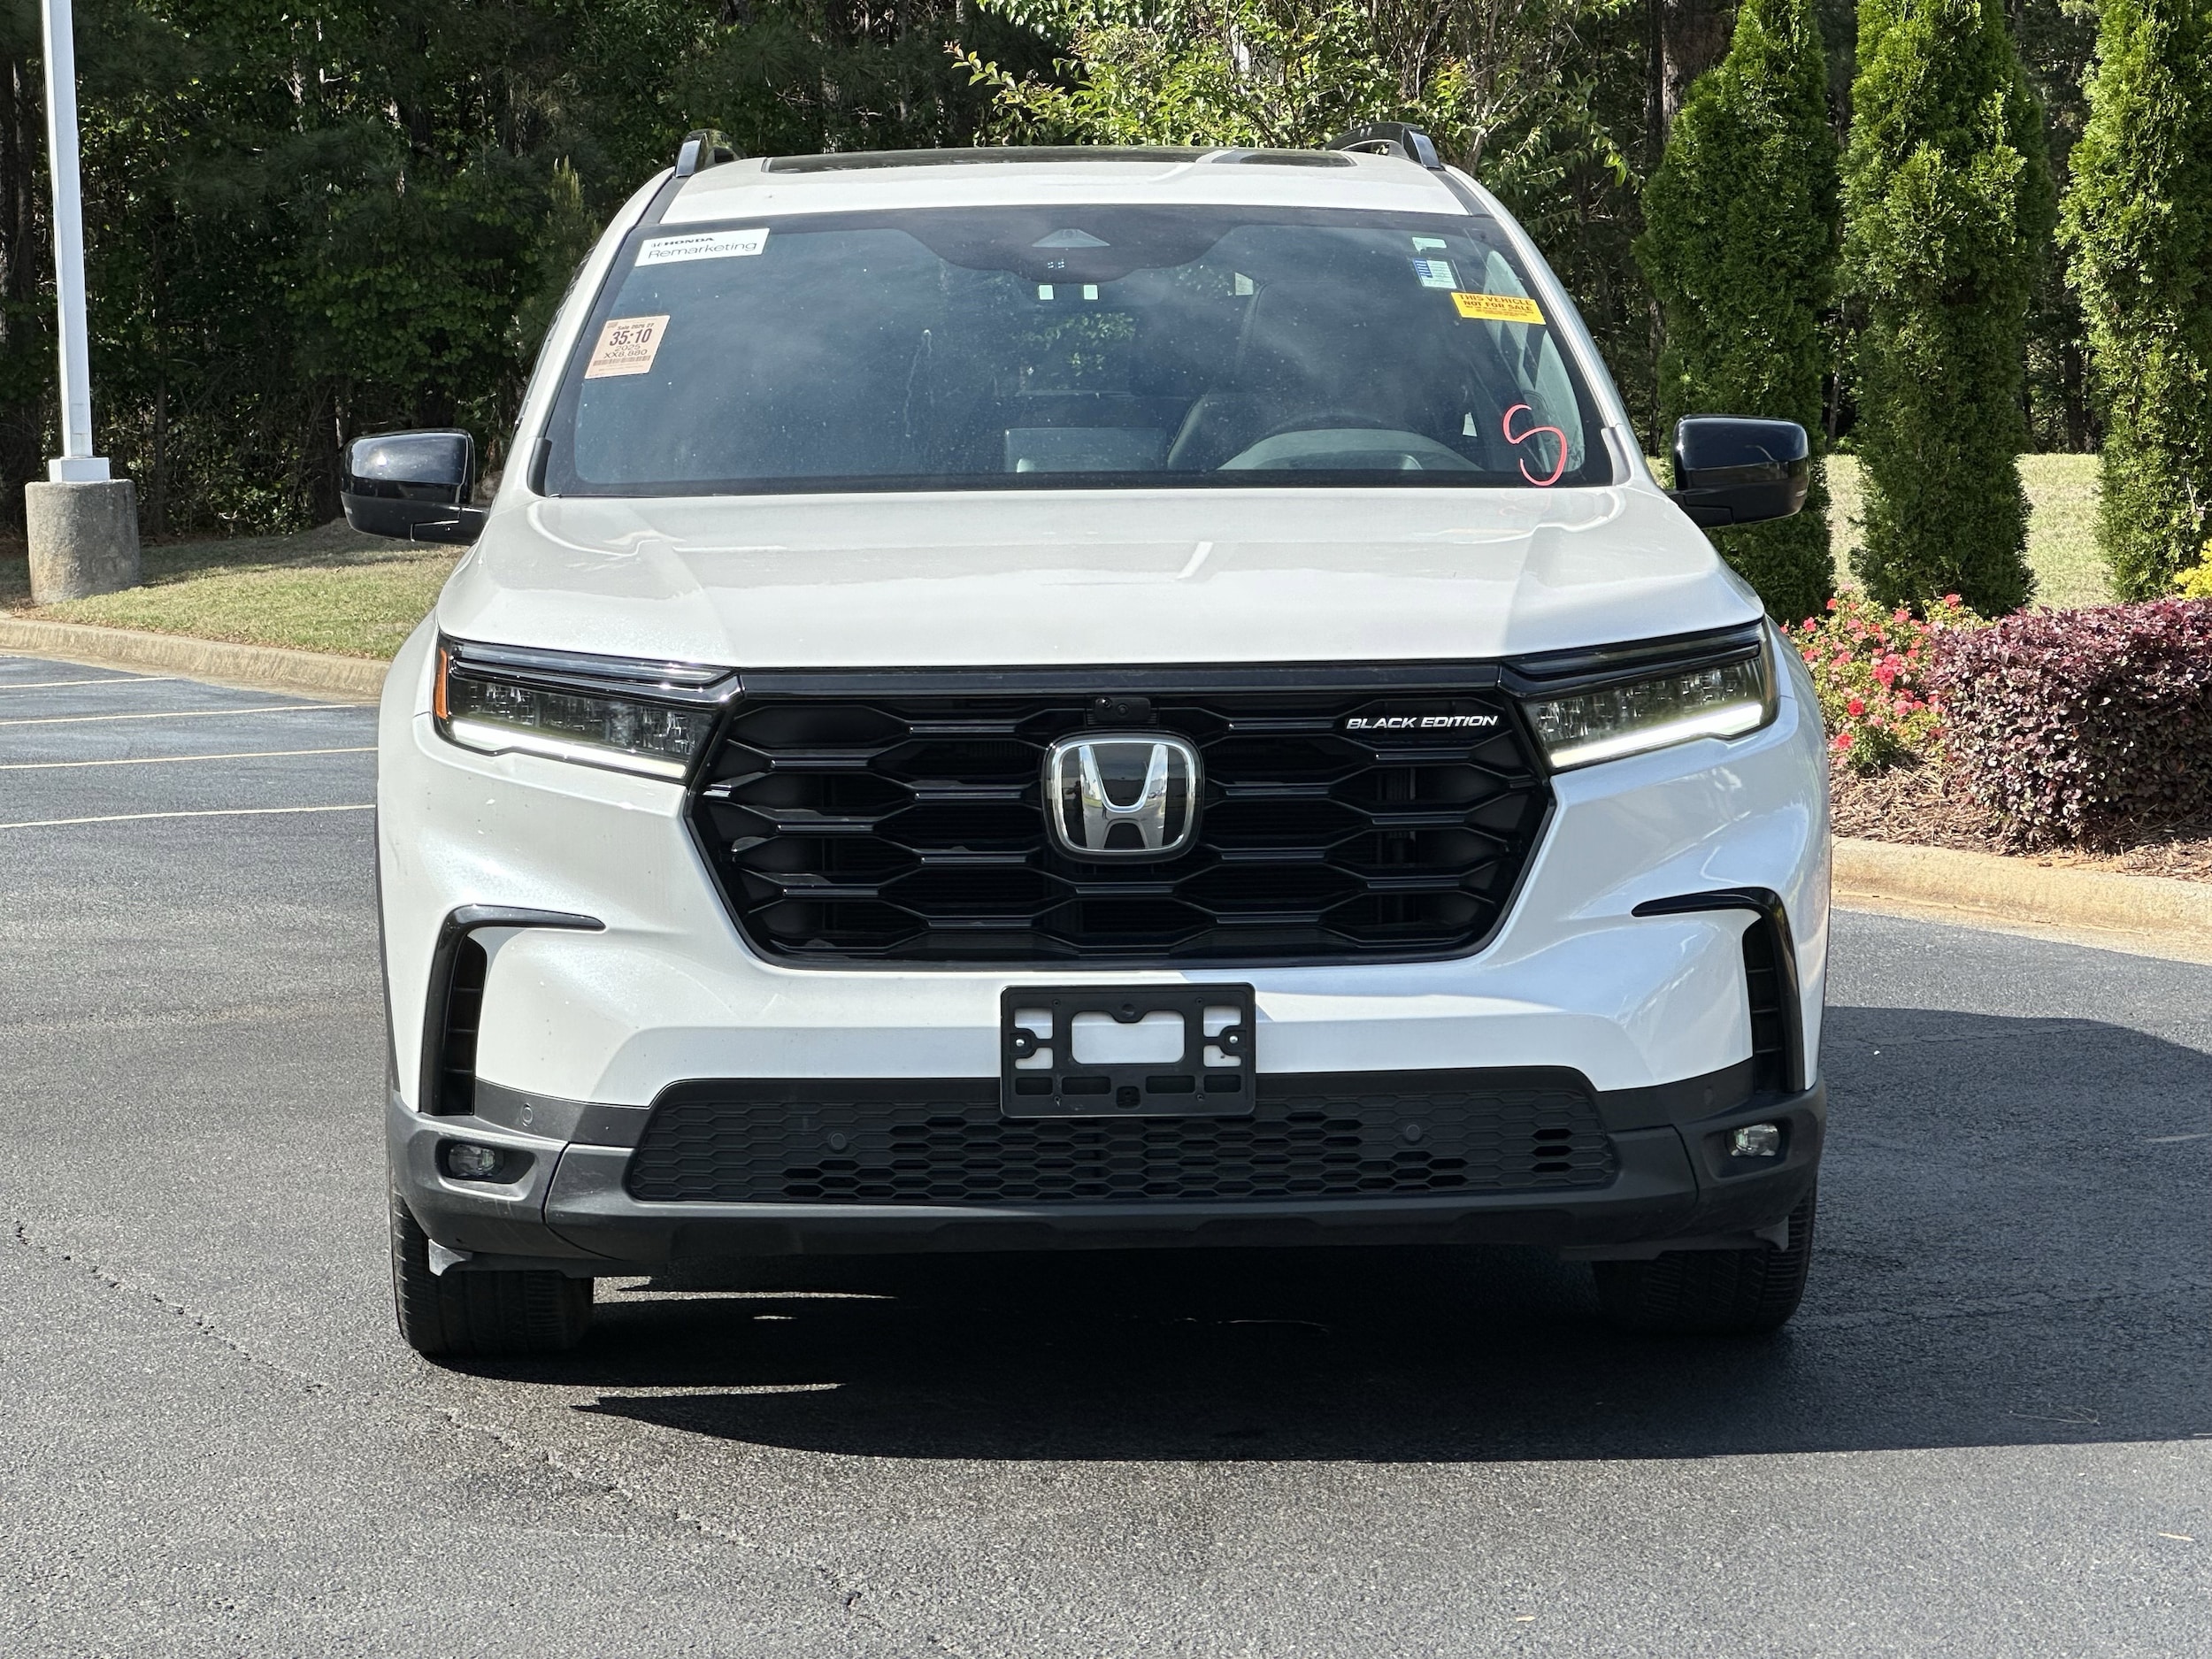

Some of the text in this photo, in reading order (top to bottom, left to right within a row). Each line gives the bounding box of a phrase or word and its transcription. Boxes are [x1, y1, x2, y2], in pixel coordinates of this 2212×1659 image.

[648, 242, 757, 259] Remarketing
[1486, 296, 1532, 306] VEHICLE
[609, 328, 653, 346] 35:10
[1346, 715, 1498, 730] BLACK EDITION
